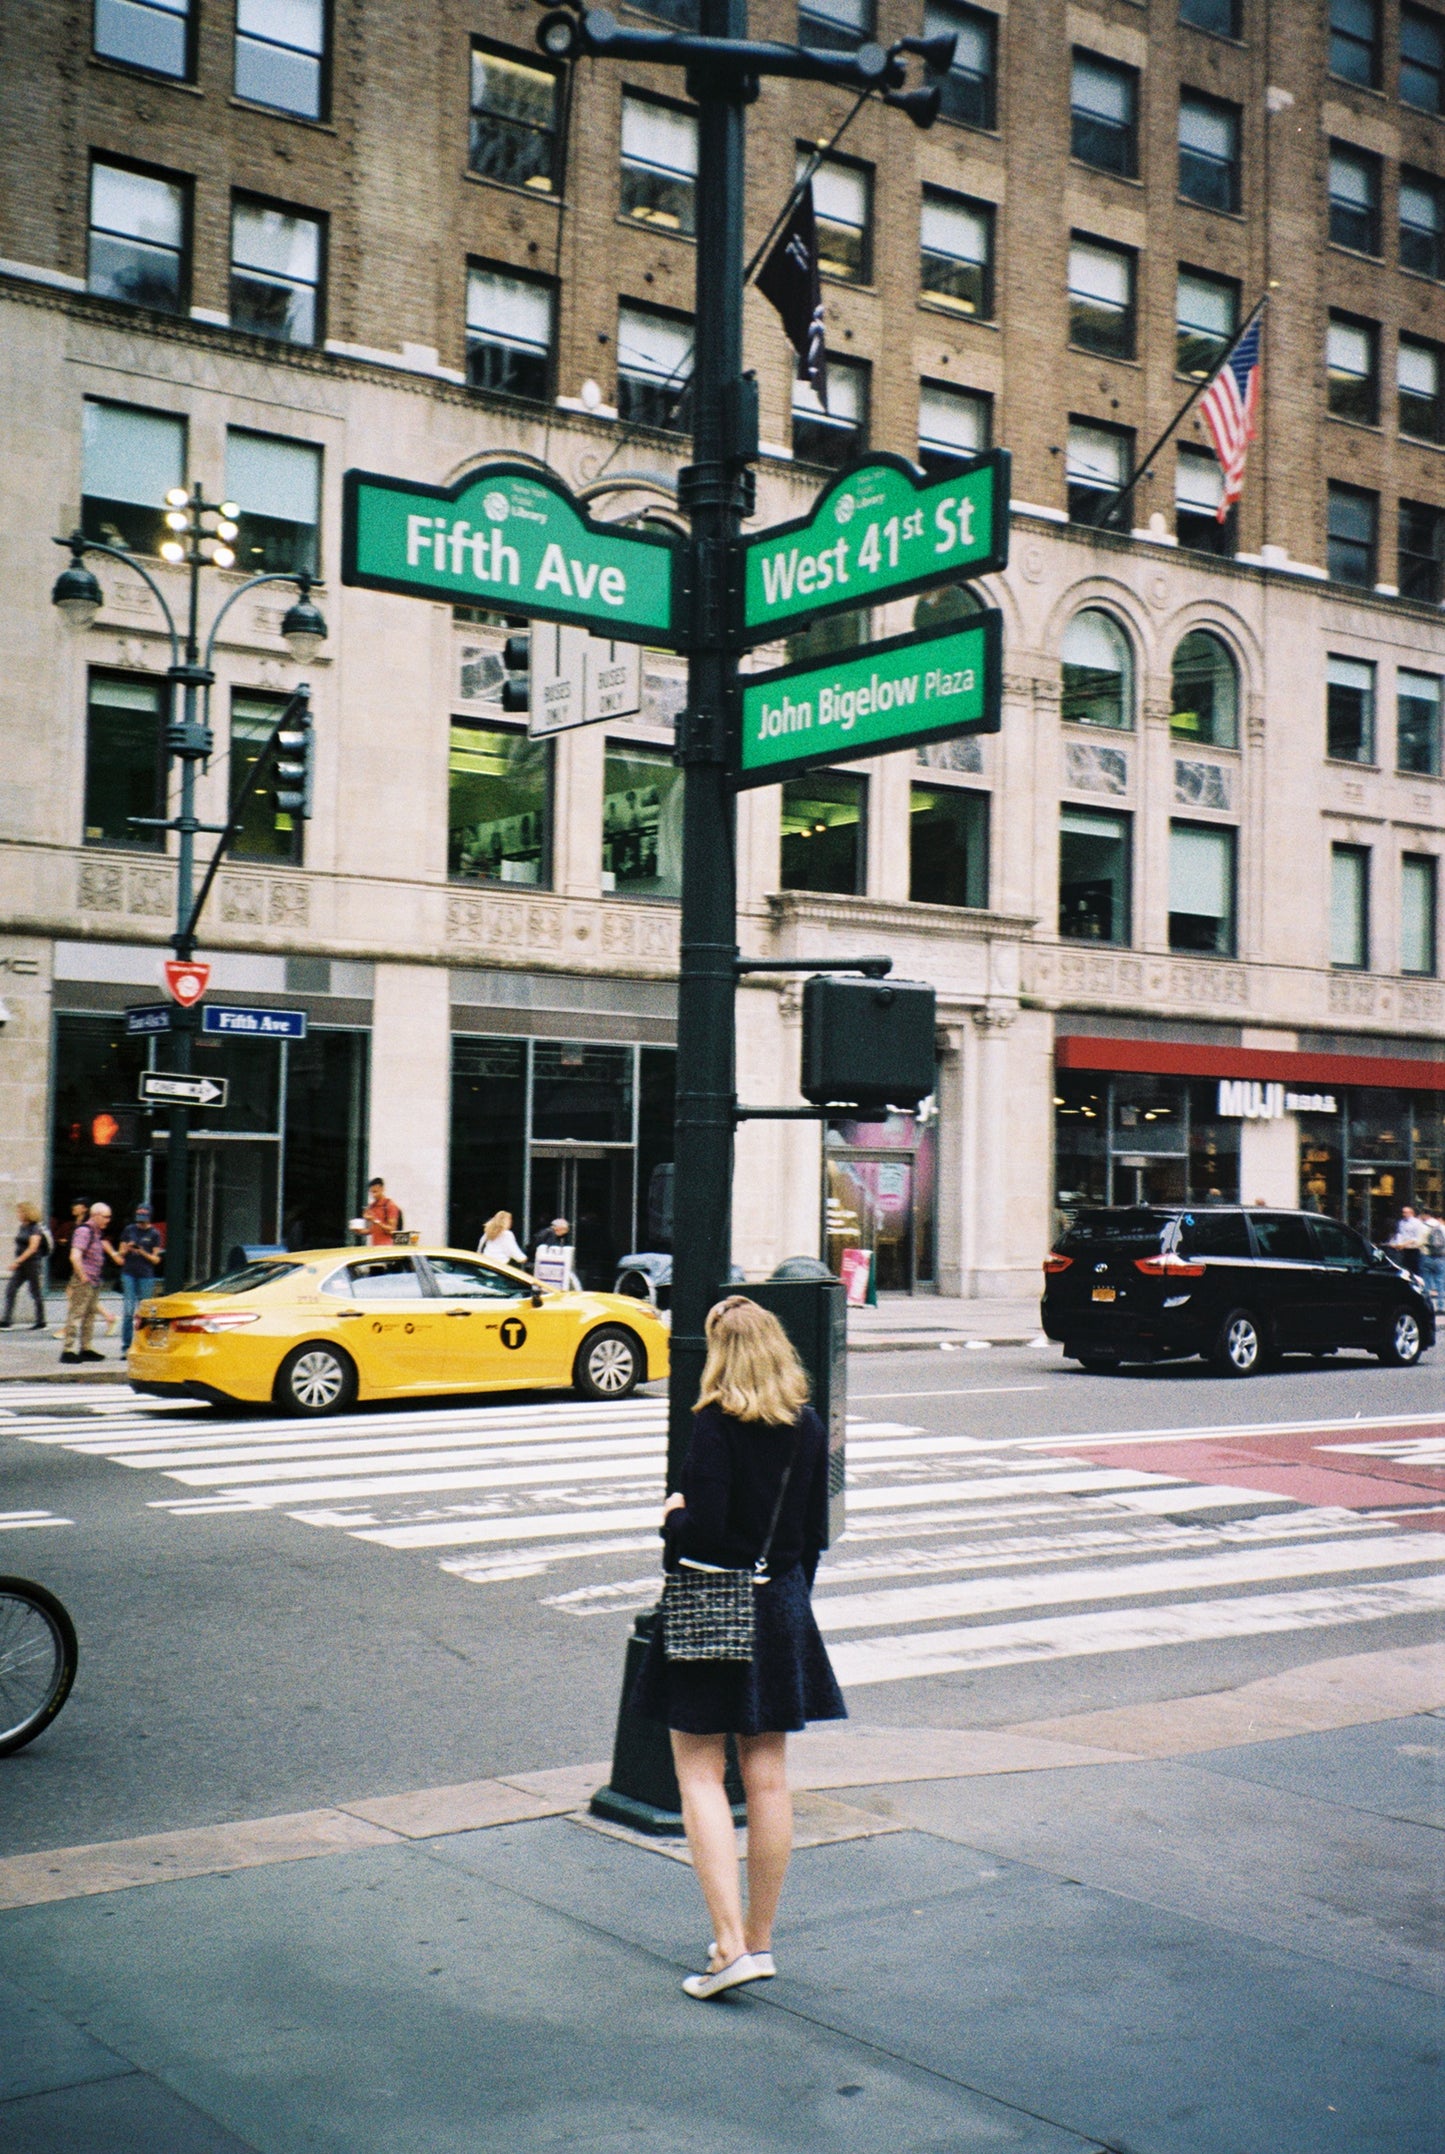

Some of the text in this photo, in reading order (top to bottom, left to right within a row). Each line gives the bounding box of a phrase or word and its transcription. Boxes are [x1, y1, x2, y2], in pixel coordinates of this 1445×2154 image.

[406, 514, 627, 606] Fifth Ave
[761, 496, 976, 605] West 41st St
[758, 668, 976, 740] John Bigelow Plaza
[219, 1012, 291, 1033] Fifth Ave
[152, 1081, 177, 1094] ONE
[1218, 1079, 1285, 1120] MUJI
